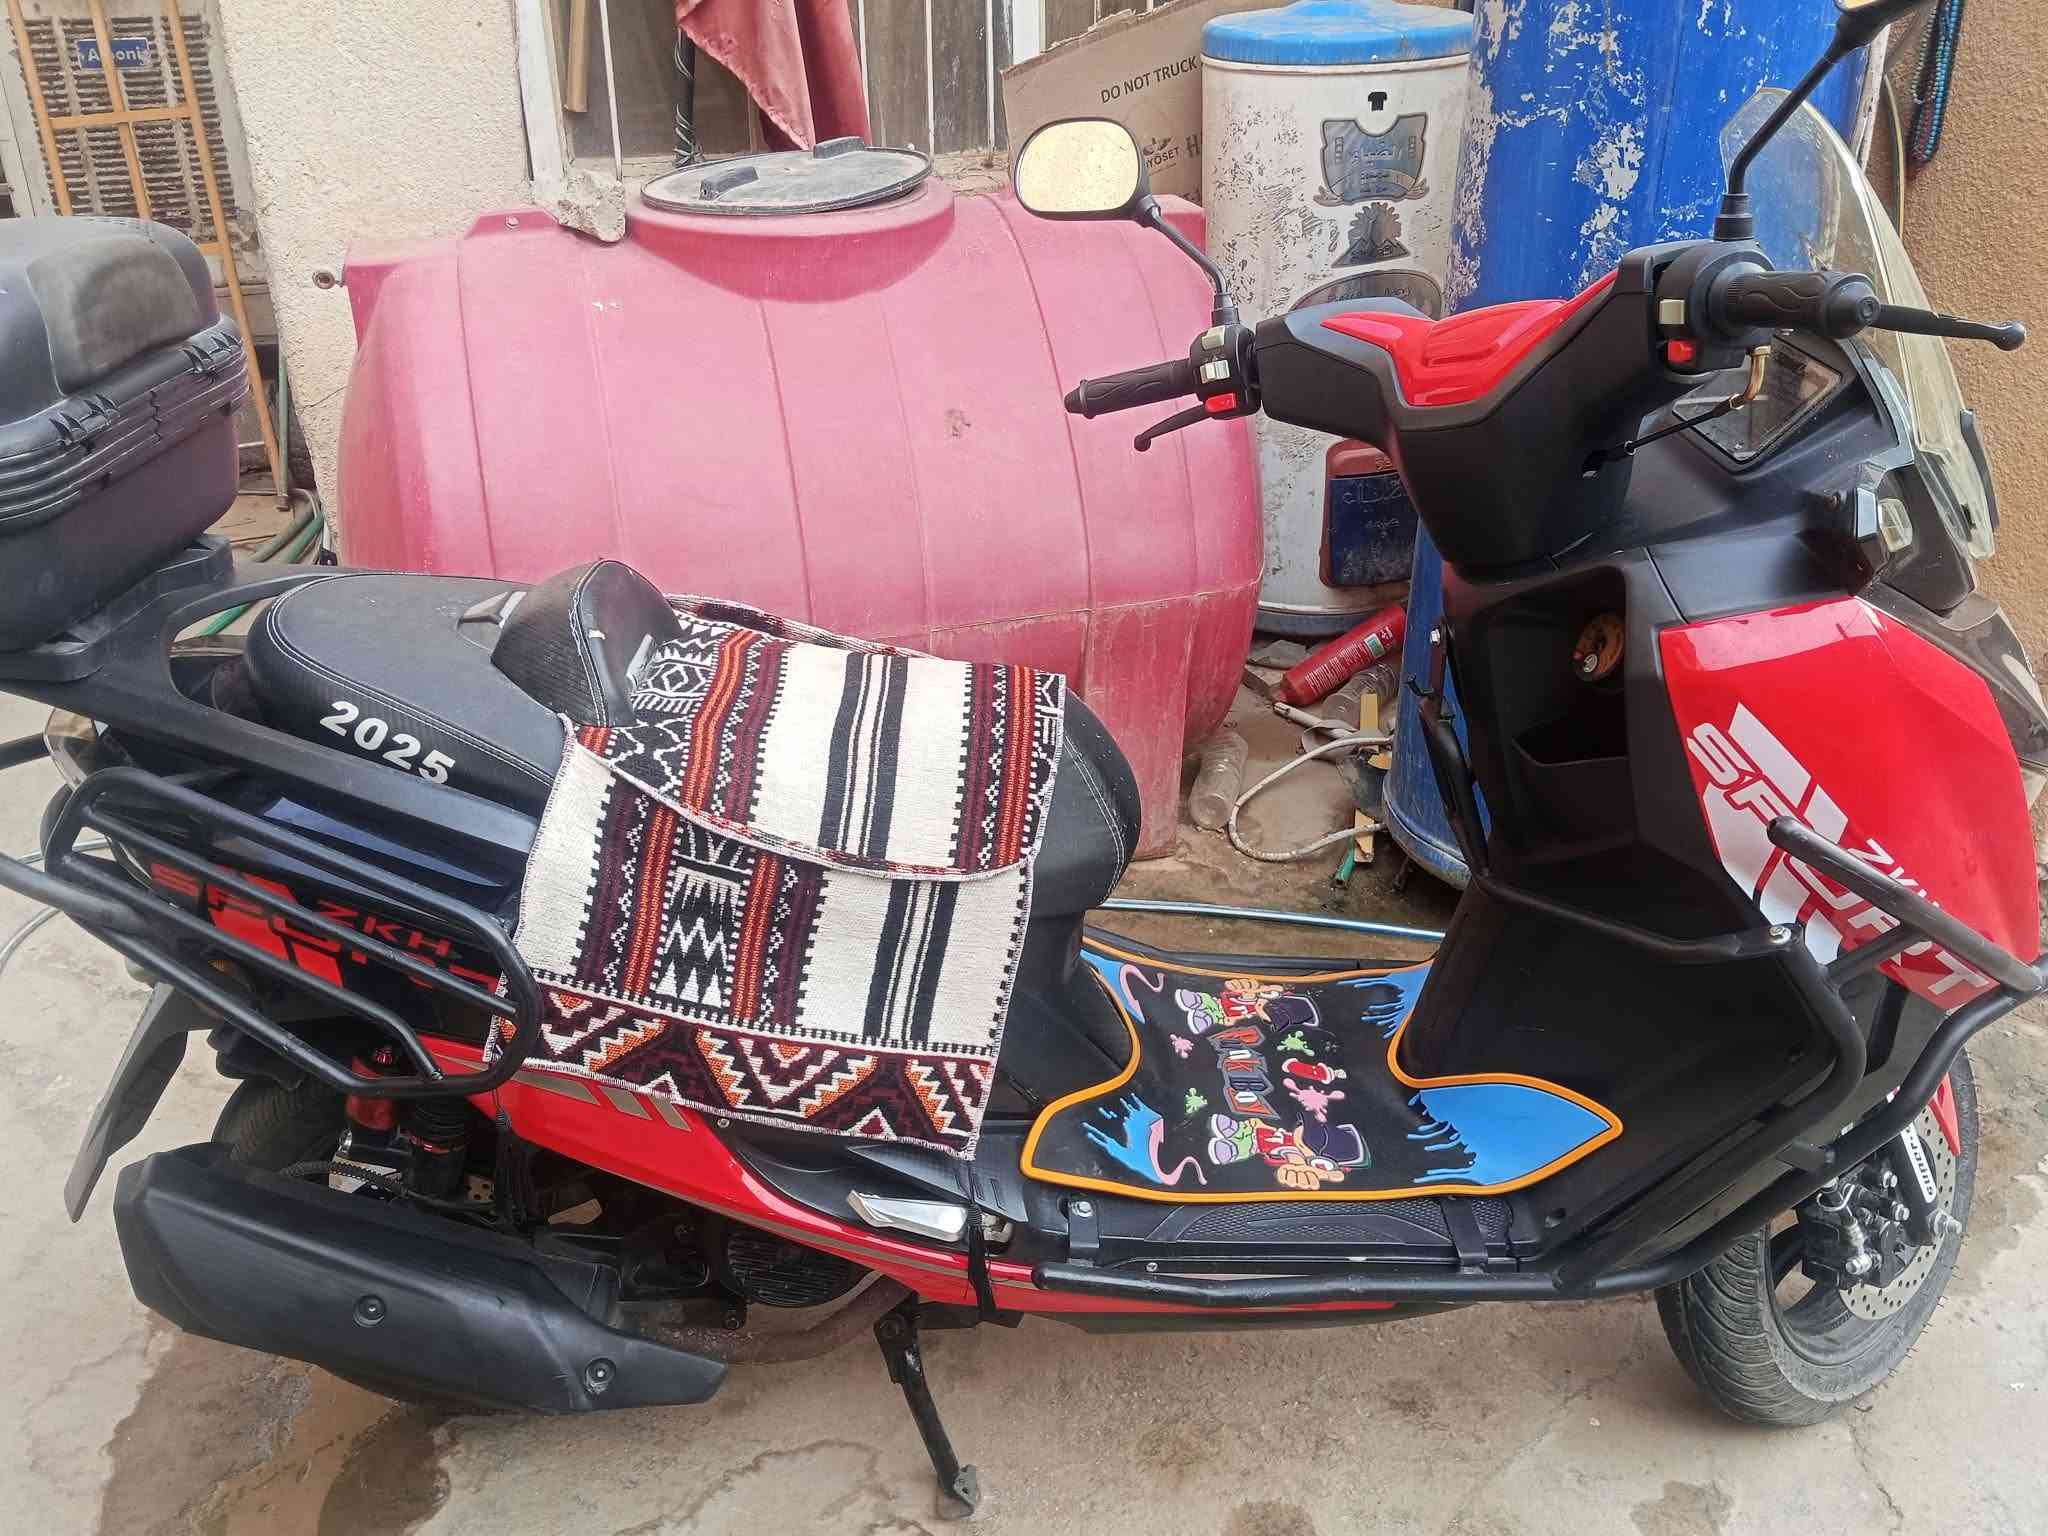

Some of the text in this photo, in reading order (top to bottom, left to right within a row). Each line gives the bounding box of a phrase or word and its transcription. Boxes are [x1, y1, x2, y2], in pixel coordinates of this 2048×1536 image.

[1101, 55, 1198, 104] DO NOT TRUCK
[319, 700, 456, 784] 2025
